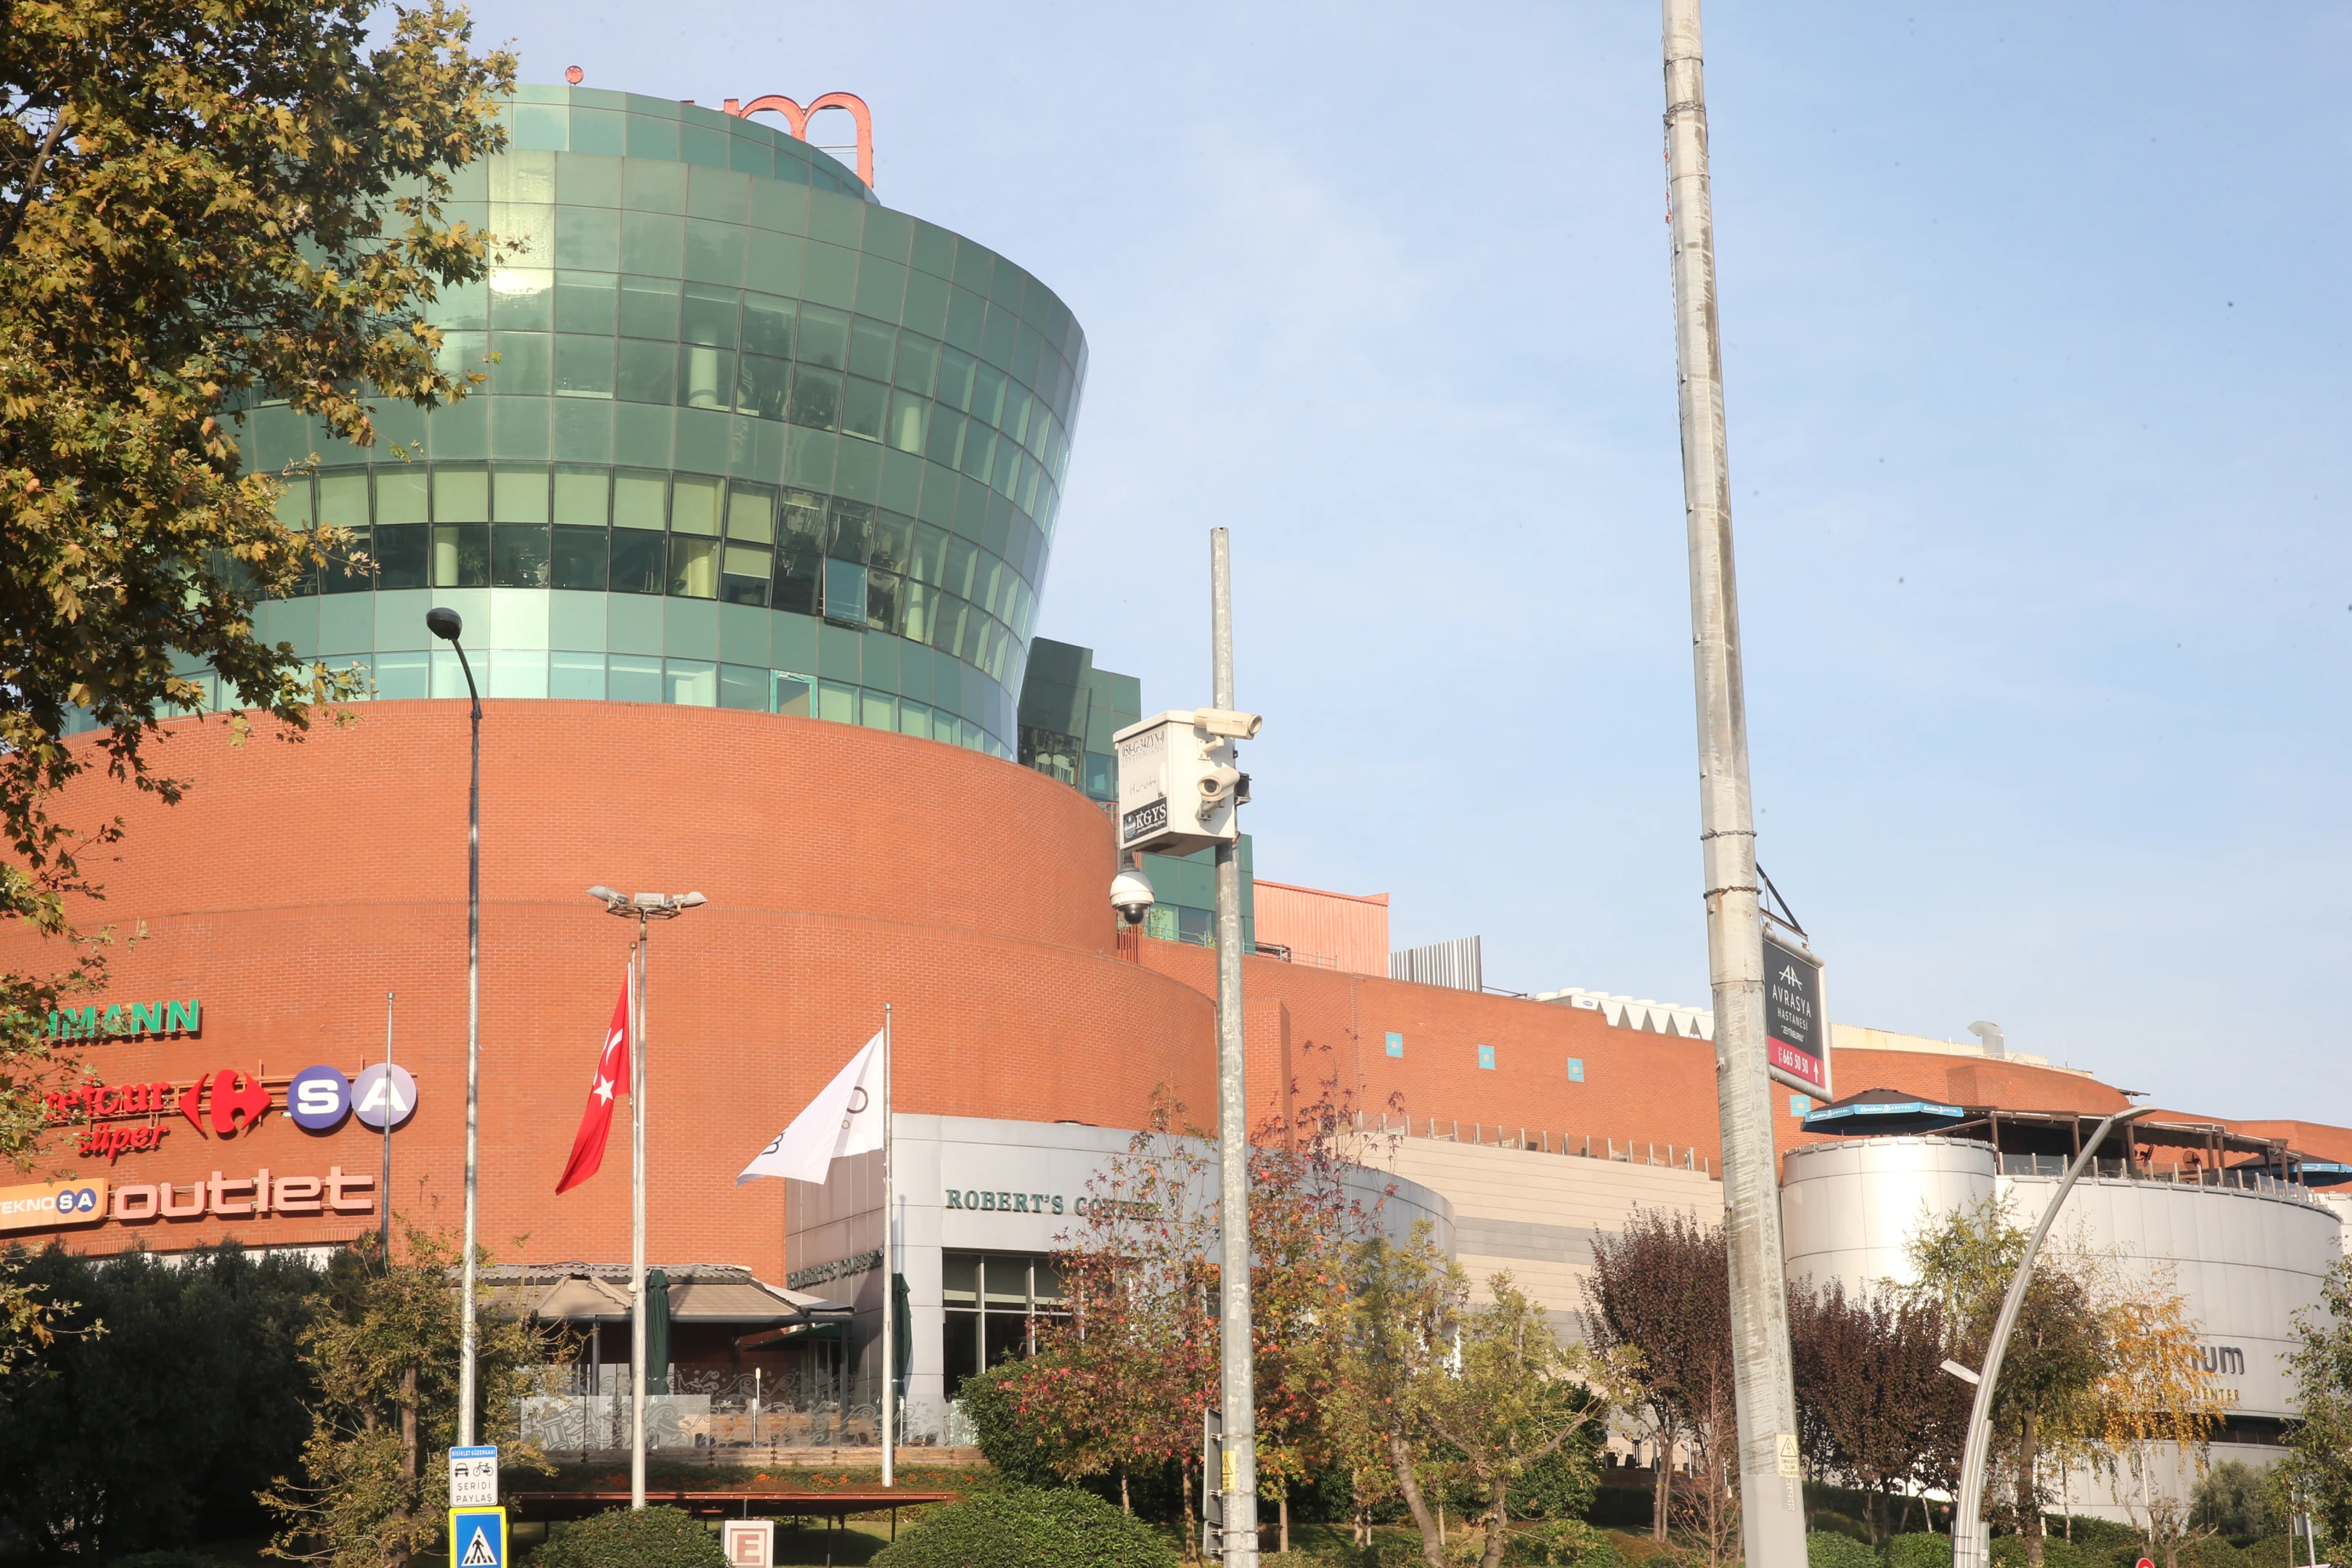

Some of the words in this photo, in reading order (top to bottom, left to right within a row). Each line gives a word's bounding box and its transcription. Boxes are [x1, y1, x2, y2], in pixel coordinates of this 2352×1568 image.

[1135, 804, 1166, 829] KGYS
[1772, 984, 1812, 1018] AVRASYA
[1777, 1007, 1808, 1031] HASTANESİ
[1783, 1048, 1793, 1066] 665
[1794, 1054, 1801, 1071] 50
[1802, 1057, 1808, 1074] 50
[78, 1122, 169, 1160] süper
[0, 1192, 93, 1215] EKNOSA
[115, 1166, 374, 1220] outlet
[945, 1189, 1063, 1214] ROBERT'S
[457, 1479, 491, 1492] ŞERİDİ
[456, 1494, 492, 1503] PAYLAŞ
[737, 1534, 760, 1563] E
